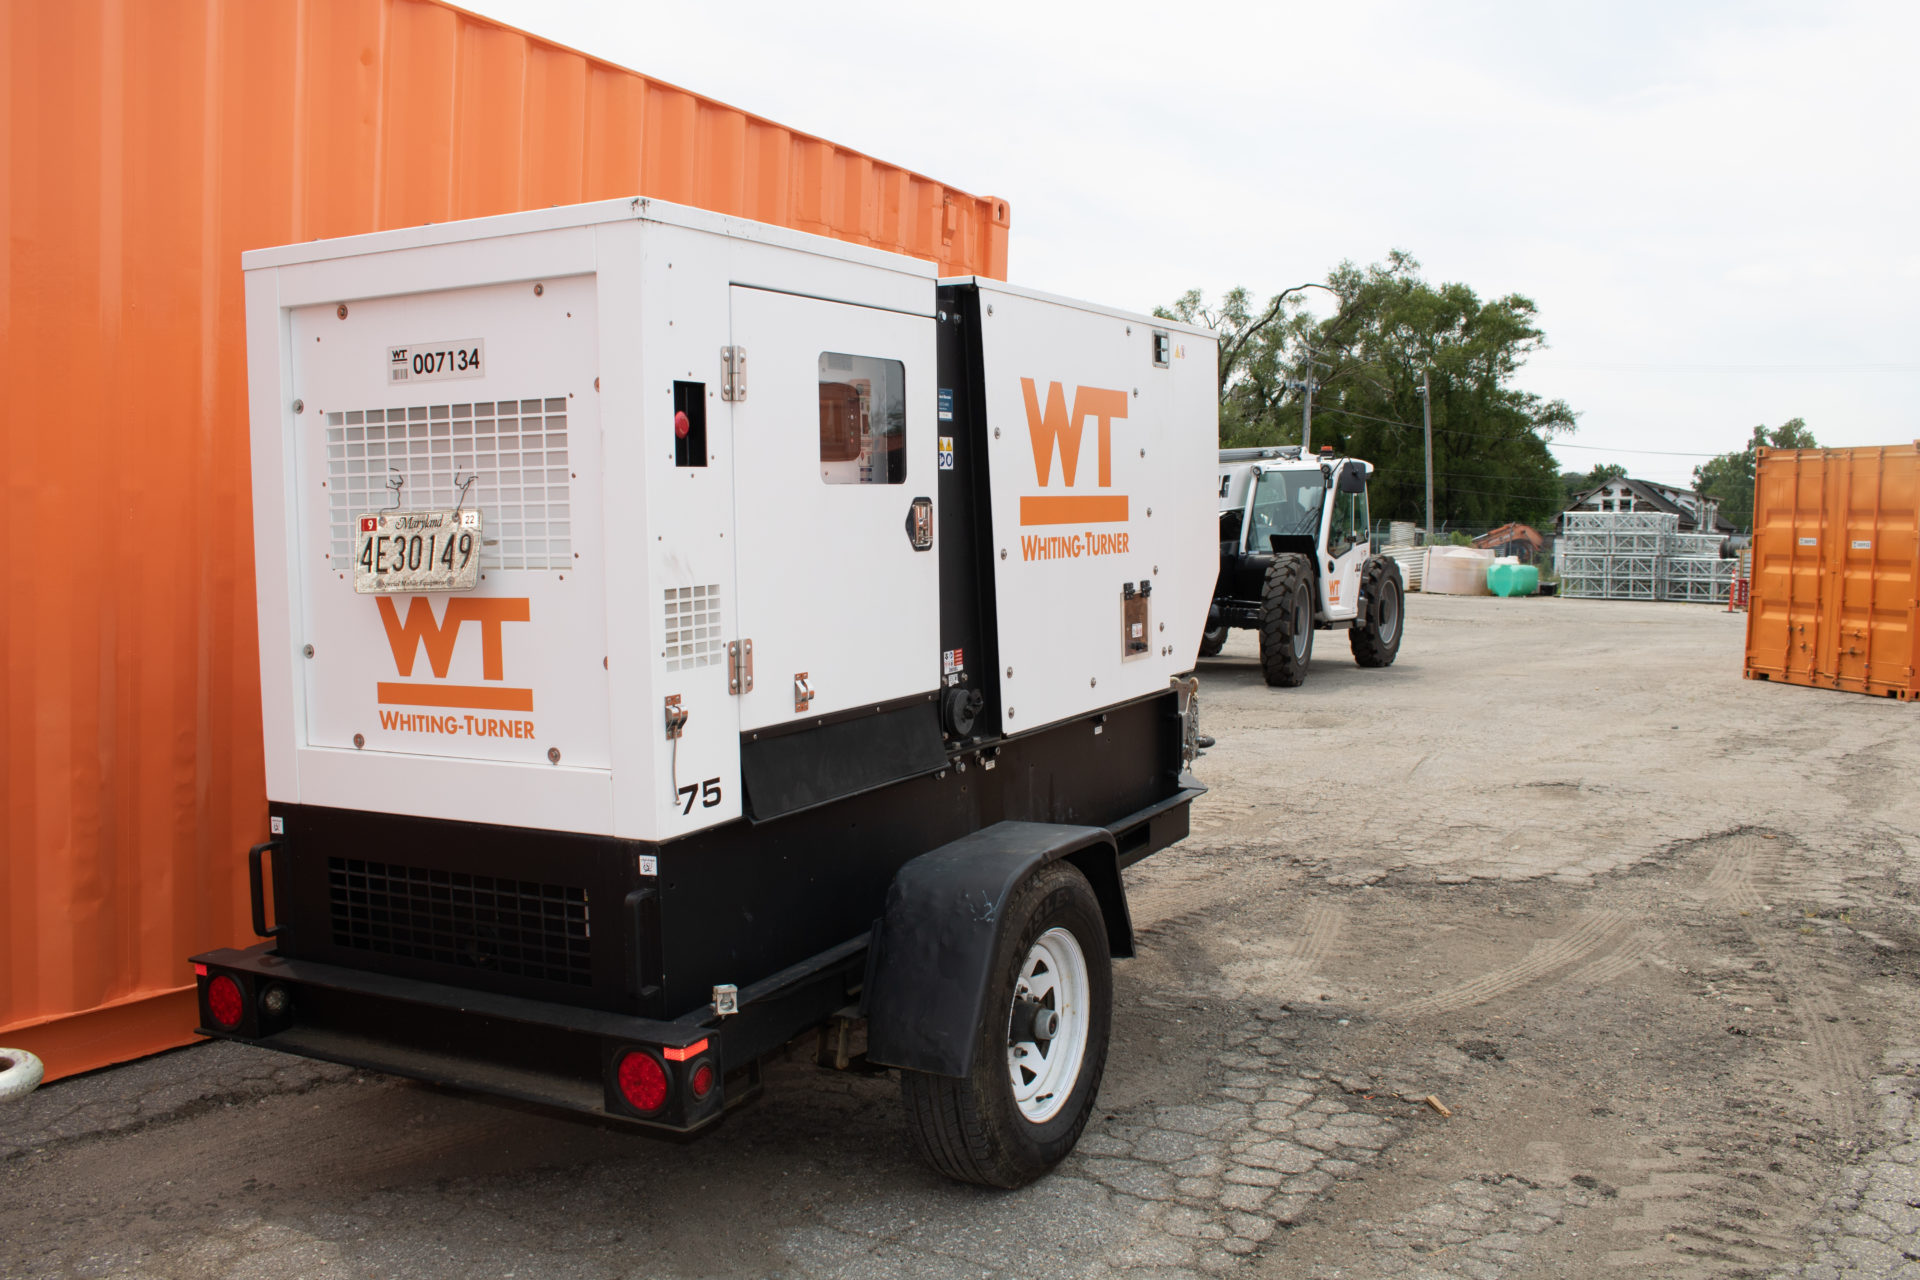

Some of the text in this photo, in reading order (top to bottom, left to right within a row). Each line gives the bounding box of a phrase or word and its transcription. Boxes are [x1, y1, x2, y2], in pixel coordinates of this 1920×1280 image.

[392, 349, 408, 359] WT
[413, 348, 480, 375] 007134
[1020, 376, 1128, 487] WT
[367, 519, 374, 530] 9
[395, 514, 444, 533] Maryland
[465, 515, 475, 525] 22
[360, 534, 472, 574] 4E30149
[1021, 532, 1130, 561] WHITING-TURNER
[1328, 579, 1341, 596] WT
[375, 596, 530, 681] WT
[378, 710, 535, 740] WHITING-TURNER
[678, 776, 722, 816] 75
